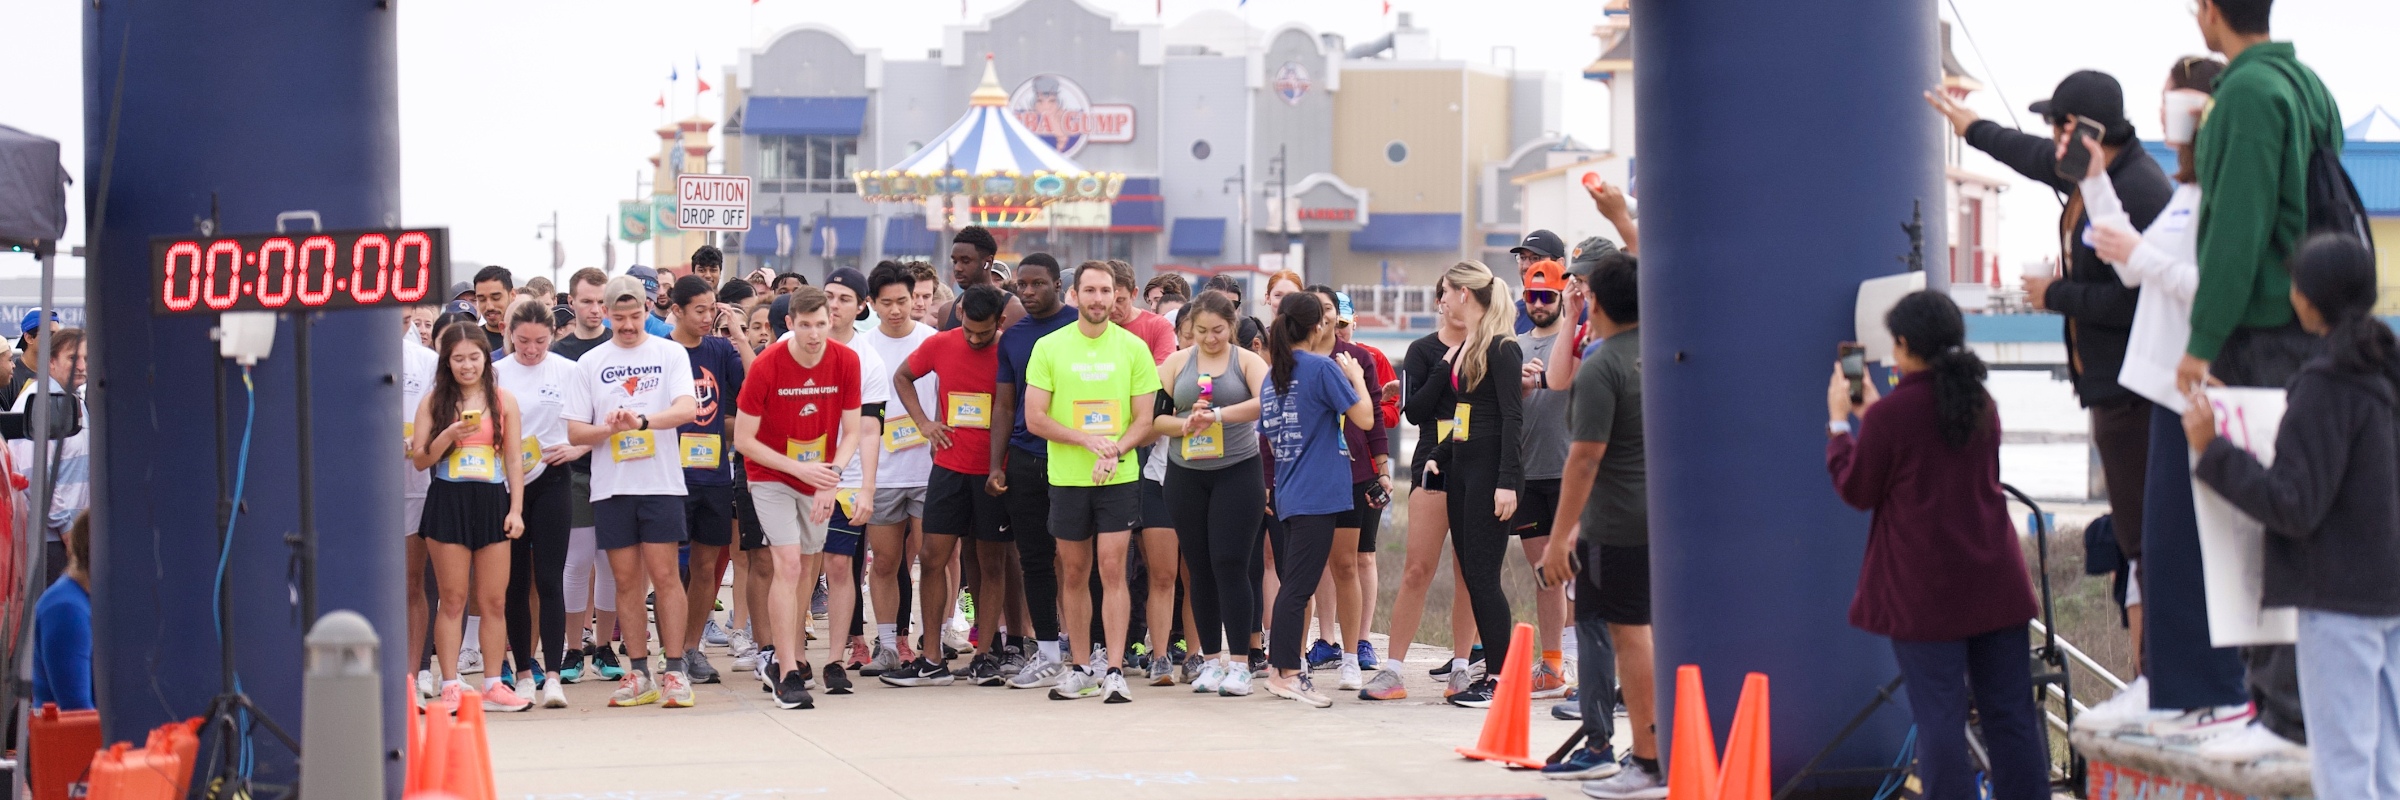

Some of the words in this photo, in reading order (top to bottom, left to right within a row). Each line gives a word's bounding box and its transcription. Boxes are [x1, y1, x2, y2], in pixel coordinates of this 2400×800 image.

[1063, 110, 1129, 135] GUMP
[684, 181, 744, 202] CAUTION
[682, 207, 715, 225] DROP
[722, 208, 745, 226] OFF
[163, 232, 431, 311] 00:00.00
[600, 365, 662, 384] Cowtown
[639, 377, 659, 391] 2023
[777, 386, 820, 396] SOUTHERN
[961, 406, 975, 415] 252
[1091, 413, 1103, 423] 50
[896, 427, 912, 437] 183
[624, 437, 640, 448] 125
[1192, 435, 1208, 446] 242
[697, 446, 707, 455] 70
[802, 451, 817, 461] 140
